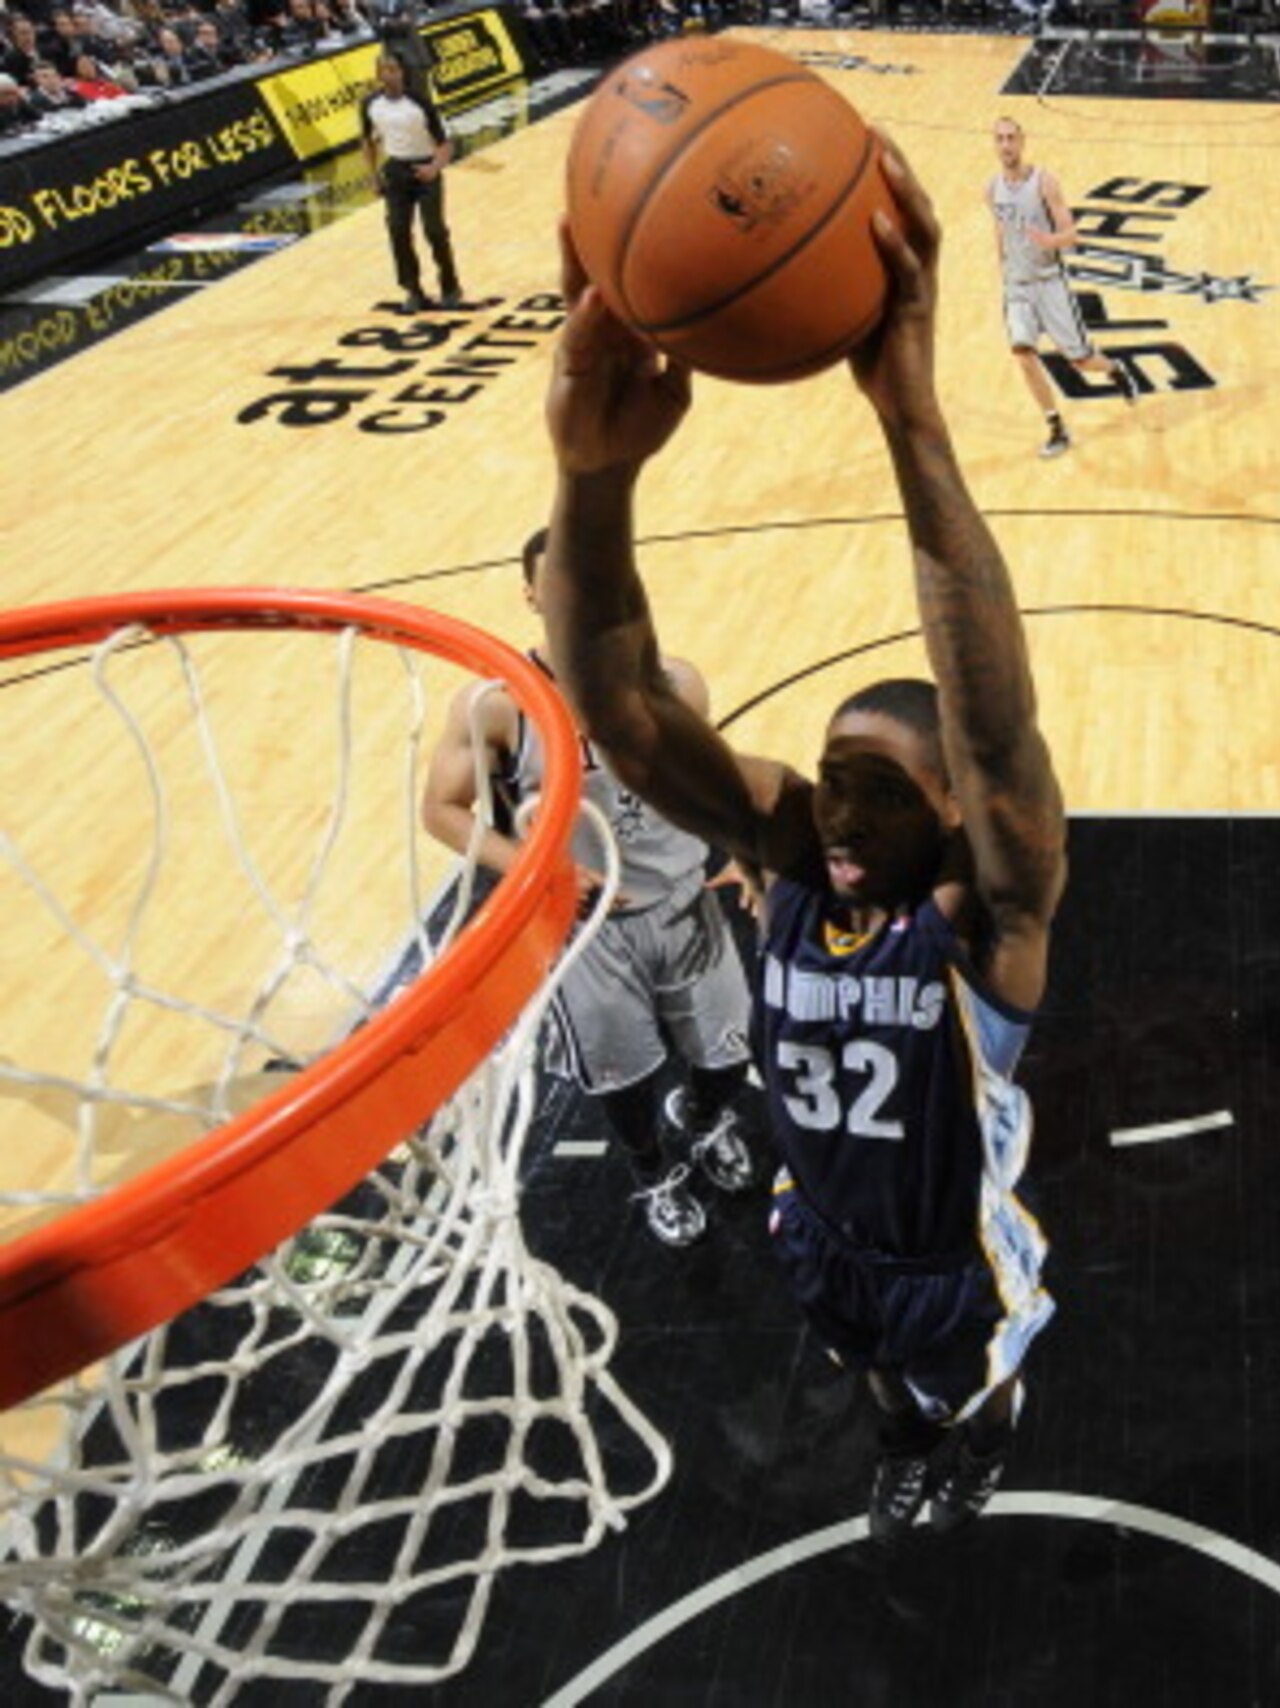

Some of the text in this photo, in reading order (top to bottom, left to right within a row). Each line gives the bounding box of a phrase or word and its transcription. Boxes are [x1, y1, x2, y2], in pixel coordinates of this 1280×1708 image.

[32, 159, 153, 230] FLOORS
[150, 141, 211, 186] FOR
[777, 1040, 905, 1139] 32
